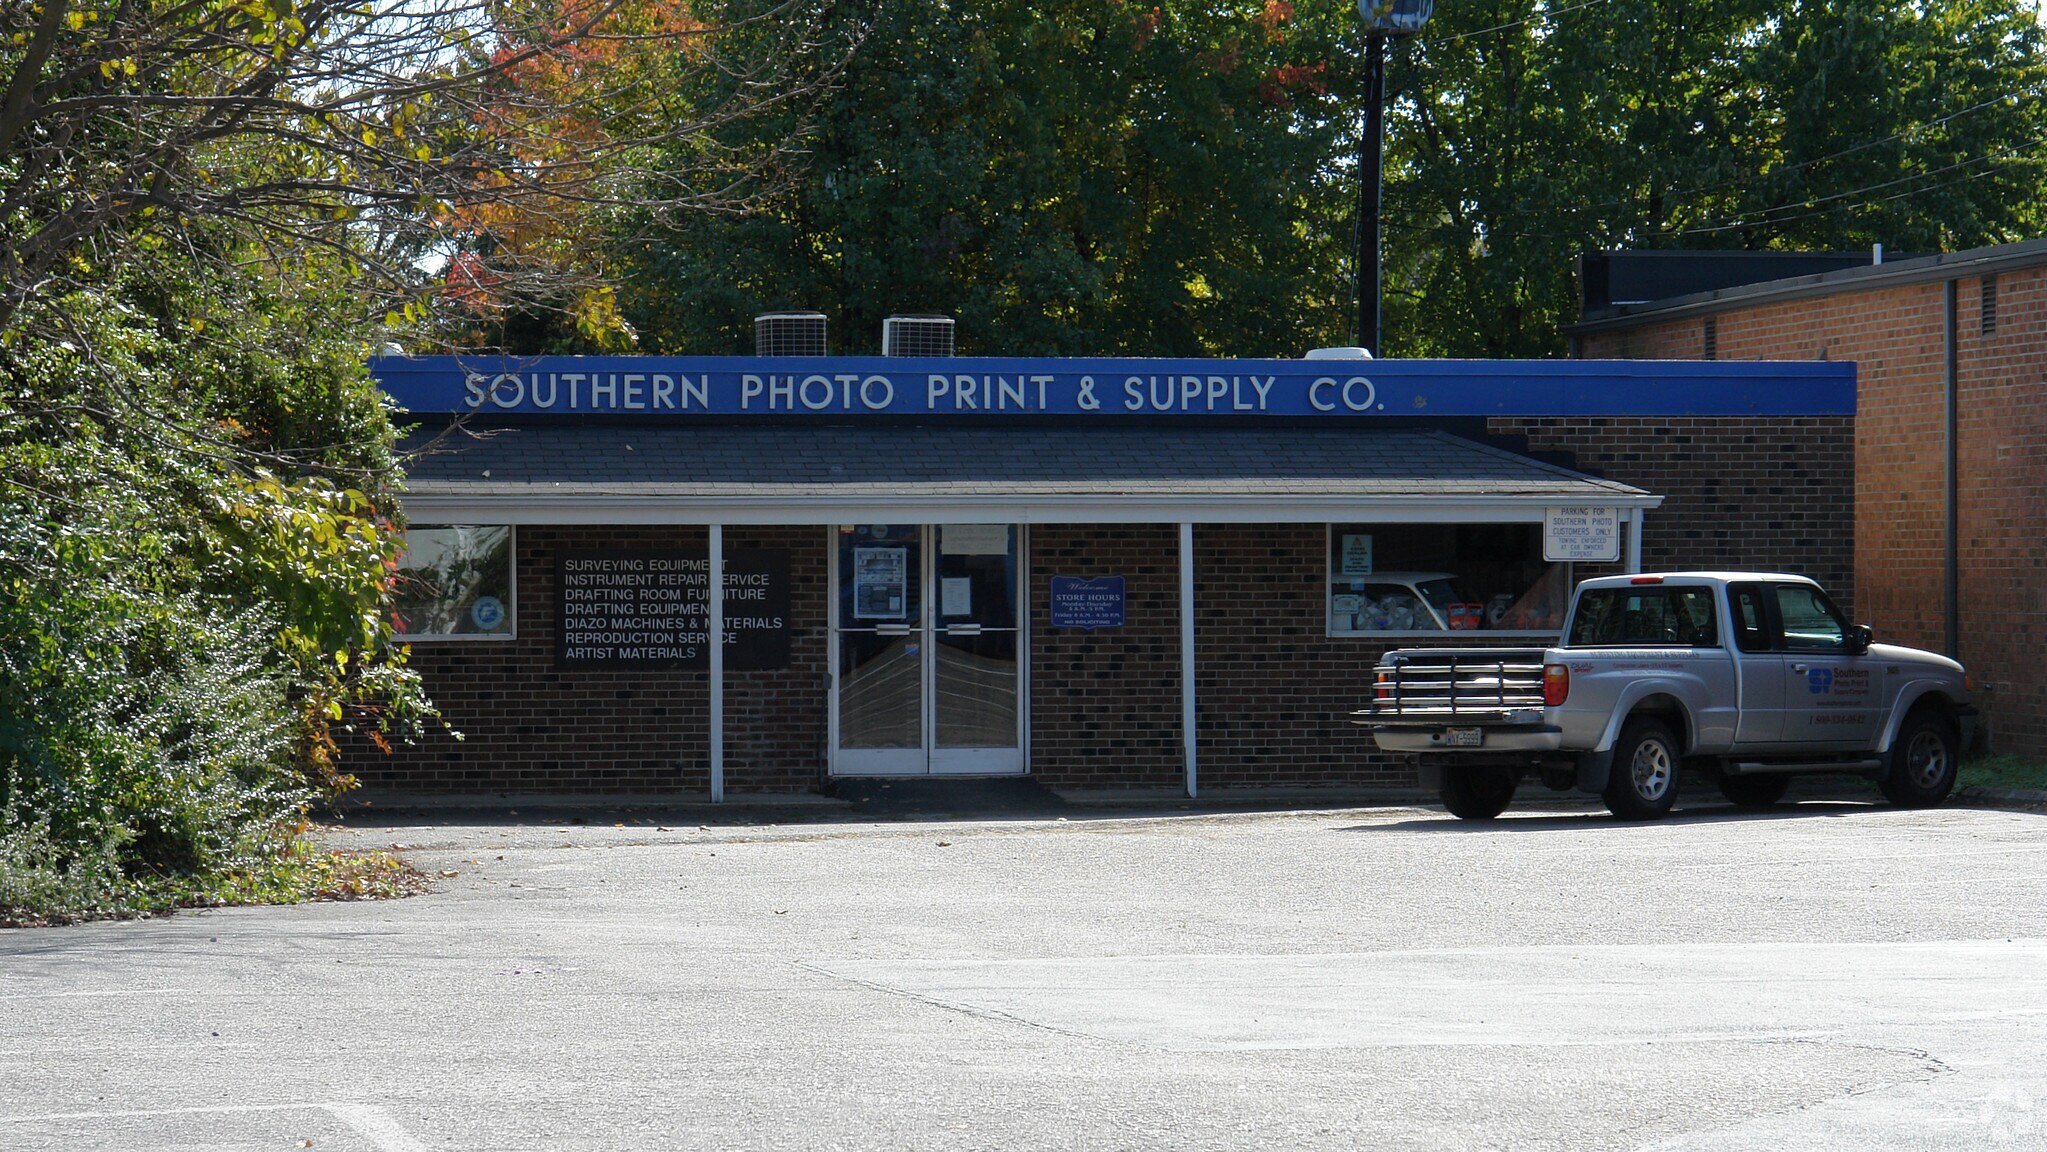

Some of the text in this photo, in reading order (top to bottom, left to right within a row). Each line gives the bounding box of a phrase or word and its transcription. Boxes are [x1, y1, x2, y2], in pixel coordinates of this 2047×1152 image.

[464, 373, 1385, 412] SOUTHERN PHOTO PRINT & SUPPLY CO.
[1561, 508, 1605, 516] PARKING FOR
[1552, 518, 1613, 526] SOUTHERN PHOTO
[1552, 528, 1612, 536] CUSTOMERS ONLY
[565, 560, 728, 571] SURVEYING EQUIPMET
[565, 574, 770, 586] INSTRUMENT REPAIR ERVICE
[565, 588, 634, 600] DRAFTING
[640, 588, 681, 600] ROOM
[565, 603, 710, 615] DRAFTING EQUIPMEN
[565, 618, 607, 629] DIAZO
[611, 618, 685, 629] MACHINES
[689, 618, 698, 629] &
[566, 632, 674, 644] REPRODUCTION
[566, 647, 696, 659] ARTIST MATERIALS
[1834, 668, 1870, 678] Southern
